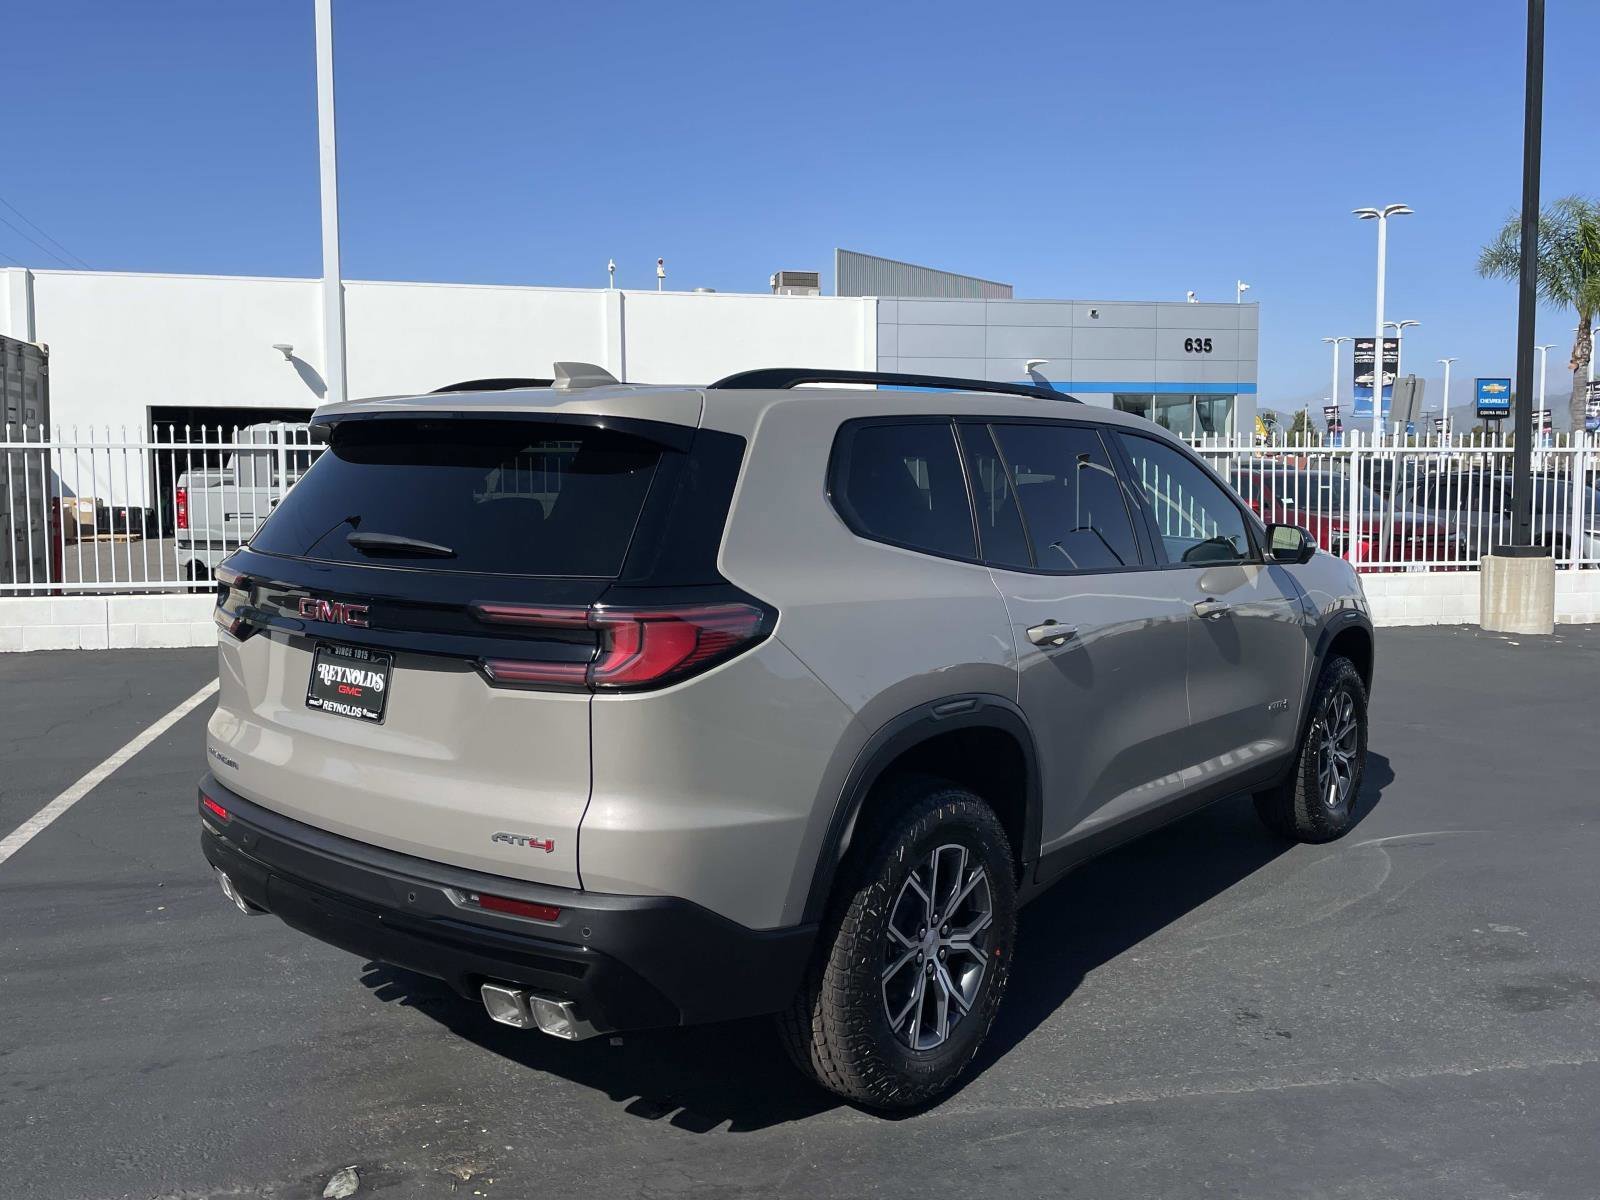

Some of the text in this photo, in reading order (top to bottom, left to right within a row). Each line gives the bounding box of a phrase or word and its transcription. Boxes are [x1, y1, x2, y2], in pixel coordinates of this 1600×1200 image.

[1184, 337, 1213, 353] 635
[299, 597, 369, 628] GMC
[334, 646, 369, 660] SINCE 1915
[317, 663, 384, 692] REYNOLDS
[338, 685, 362, 697] GMC
[322, 700, 362, 717] REYNOLDS
[491, 831, 555, 854] AT4
